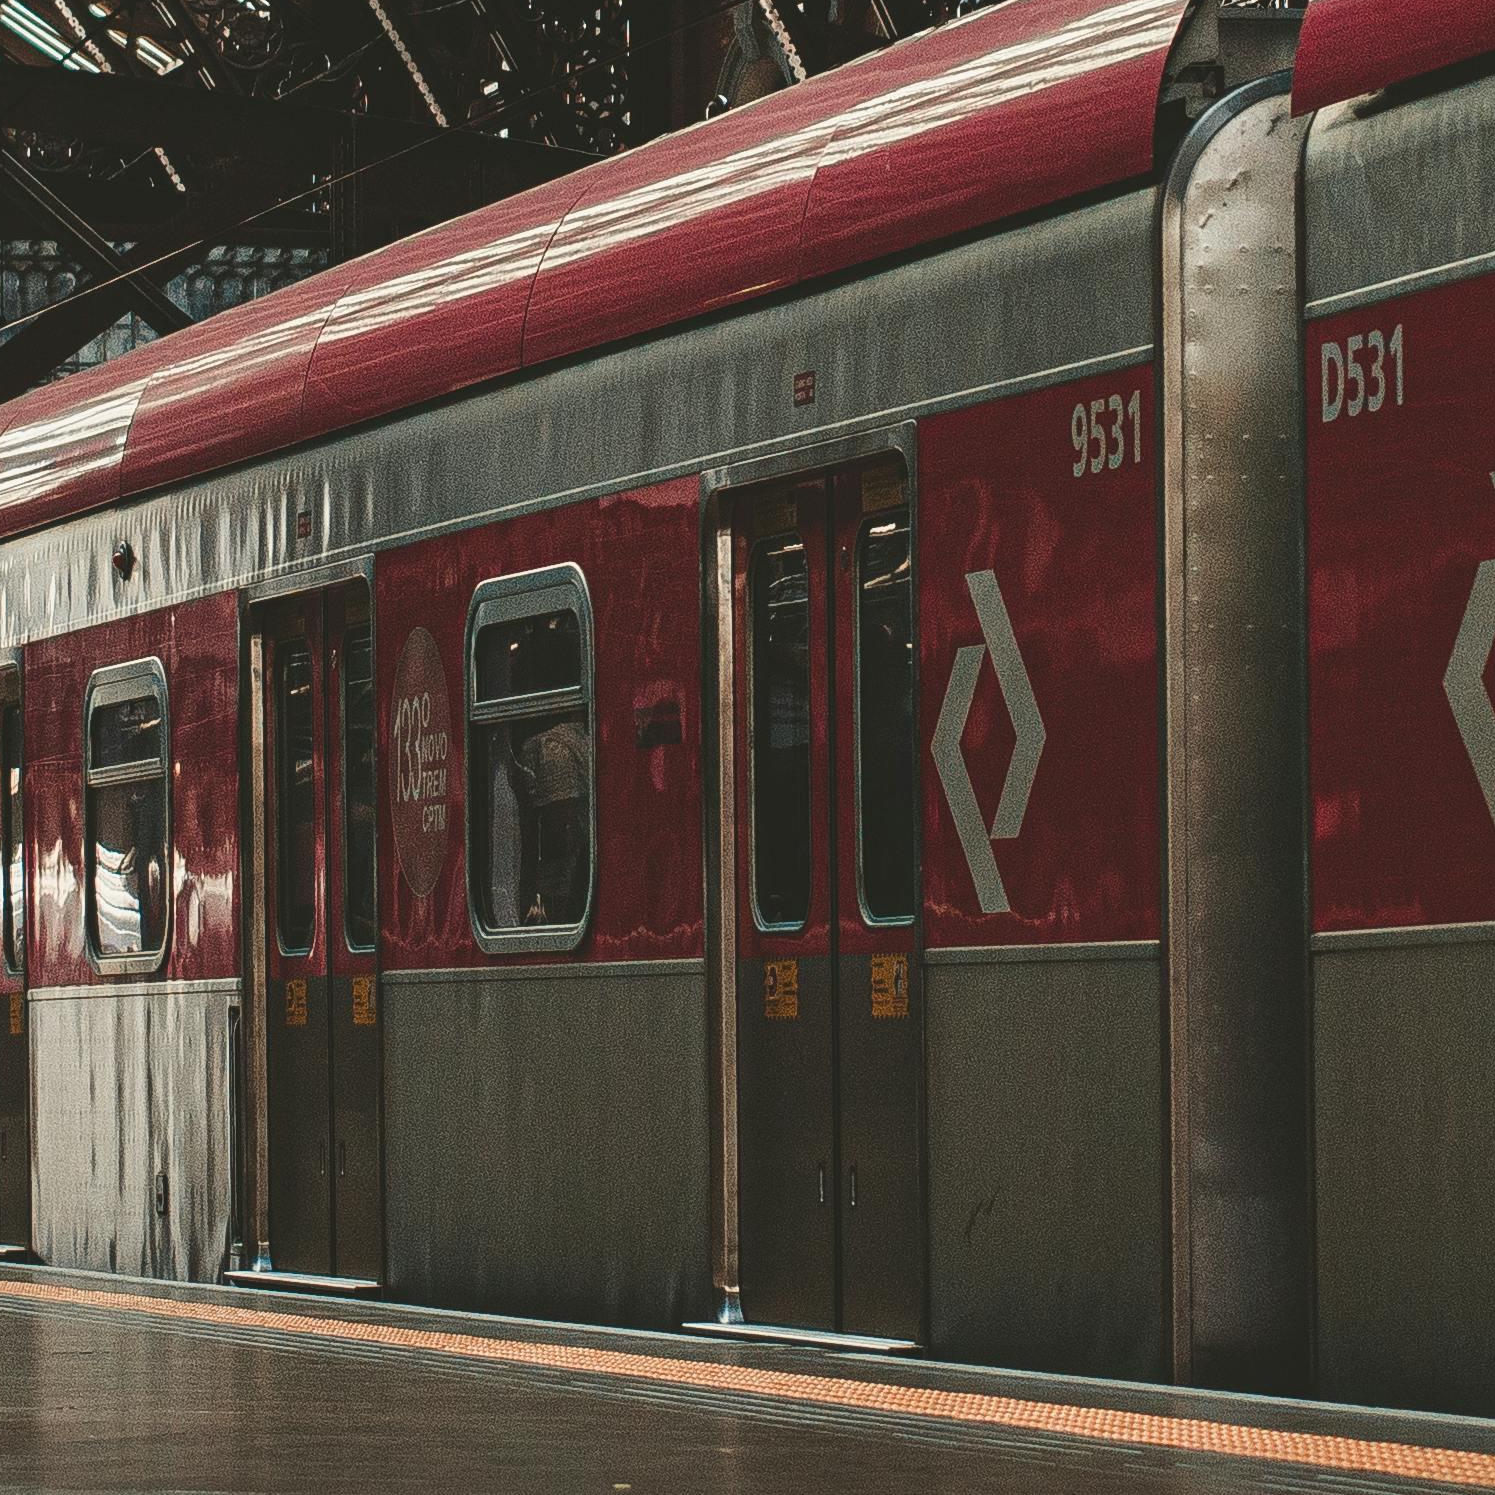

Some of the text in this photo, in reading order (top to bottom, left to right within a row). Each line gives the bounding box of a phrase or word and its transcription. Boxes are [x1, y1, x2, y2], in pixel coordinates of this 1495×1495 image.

[1321, 323, 1404, 423] D531
[1071, 389, 1142, 478] 9531
[421, 731, 447, 763] NOVO
[422, 768, 447, 799] TREM
[422, 803, 447, 833] CPTM
